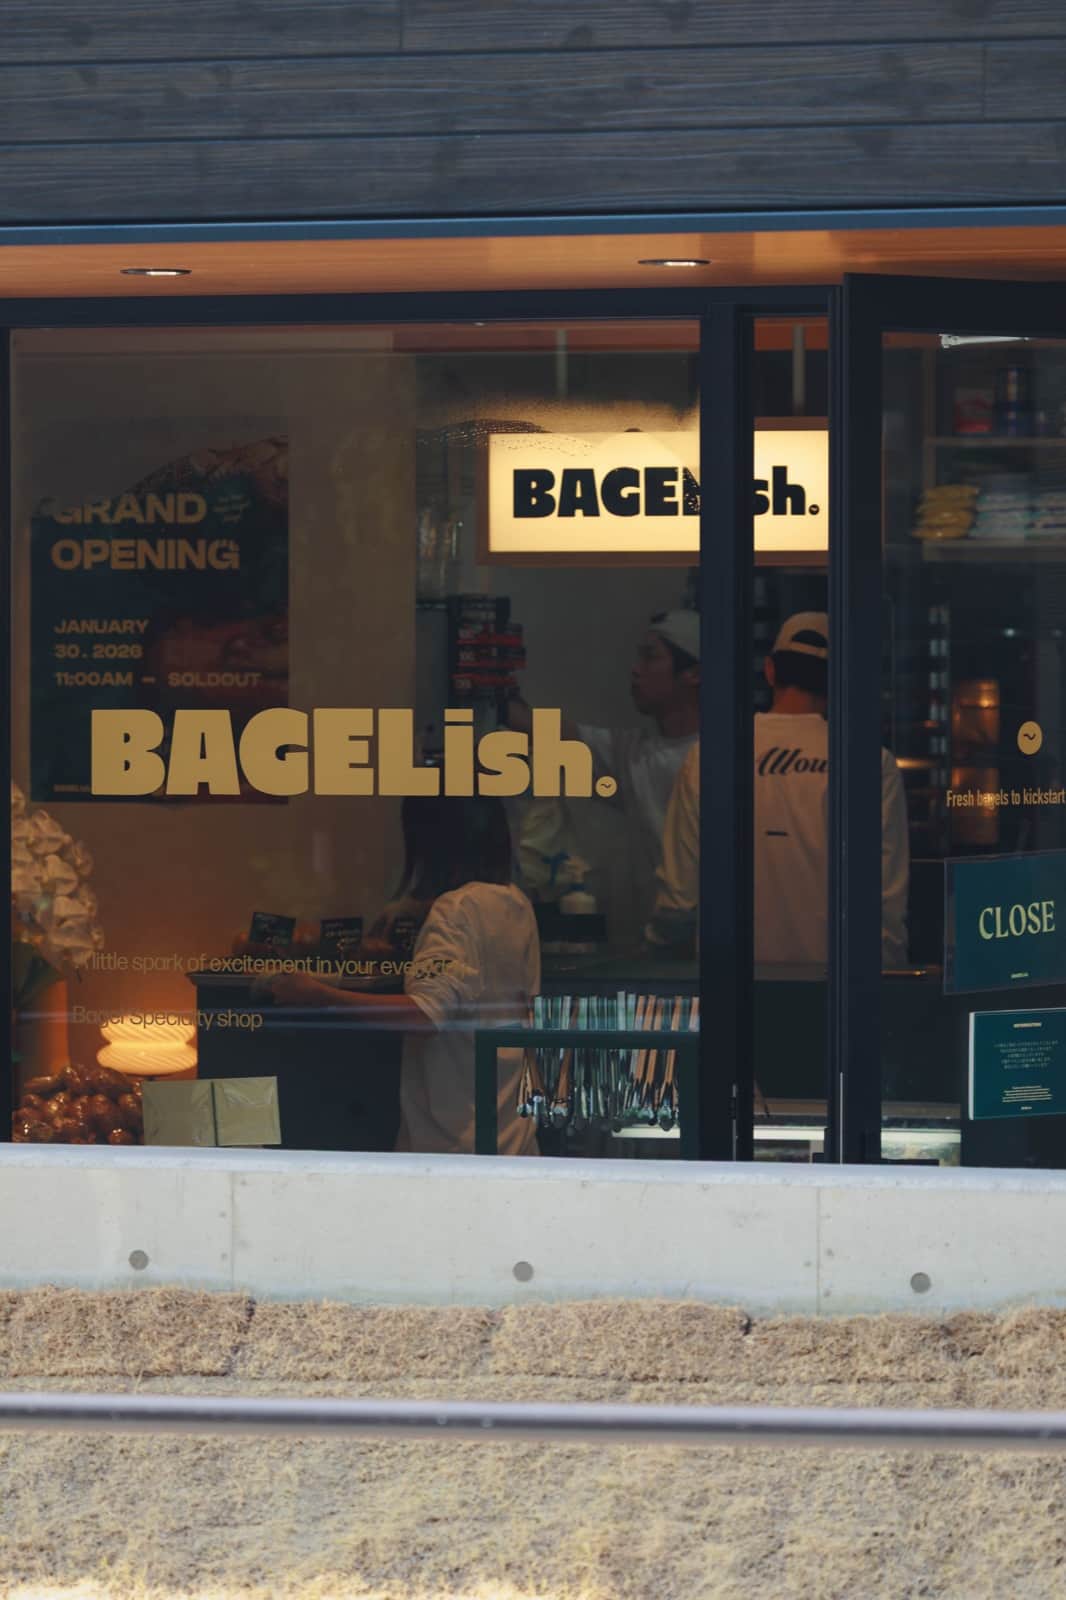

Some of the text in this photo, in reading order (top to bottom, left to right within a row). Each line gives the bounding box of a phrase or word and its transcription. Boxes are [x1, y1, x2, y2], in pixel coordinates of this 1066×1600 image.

[51, 539, 240, 570] OPENING
[54, 620, 149, 635] JANUARY
[54, 672, 133, 687] 11:00AM
[167, 672, 262, 688] SOLDOUT
[946, 789, 974, 808] Fresh
[1011, 788, 1021, 806] to
[1023, 786, 1066, 806] kickstart
[978, 900, 1056, 940] CLOSE
[92, 952, 129, 970] little
[131, 953, 183, 975] spark
[187, 954, 208, 971] of
[210, 955, 314, 974] excitement
[316, 957, 332, 974] in
[334, 960, 378, 978] your
[217, 1009, 263, 1030] shop
